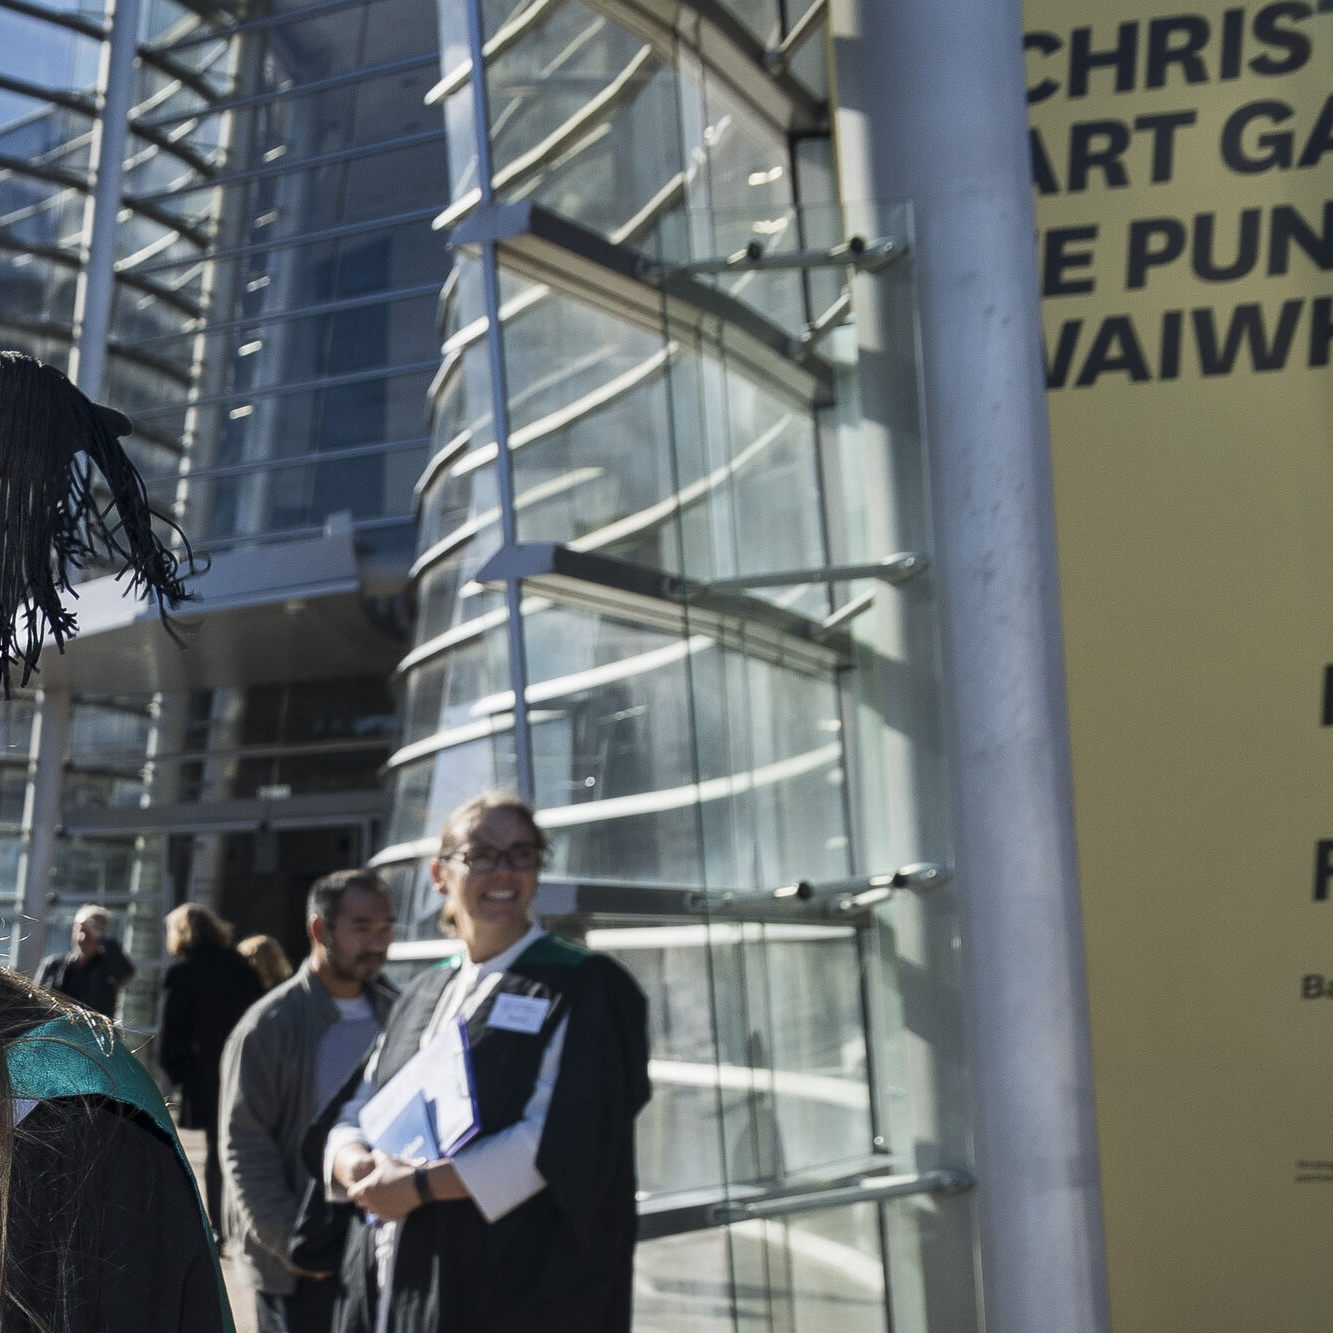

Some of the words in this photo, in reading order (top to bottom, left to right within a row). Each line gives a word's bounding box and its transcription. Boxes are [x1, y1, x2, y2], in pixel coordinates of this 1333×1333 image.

[1023, 0, 1333, 106] CHRIS
[1036, 222, 1100, 298] E
[1125, 199, 1333, 292] PUN
